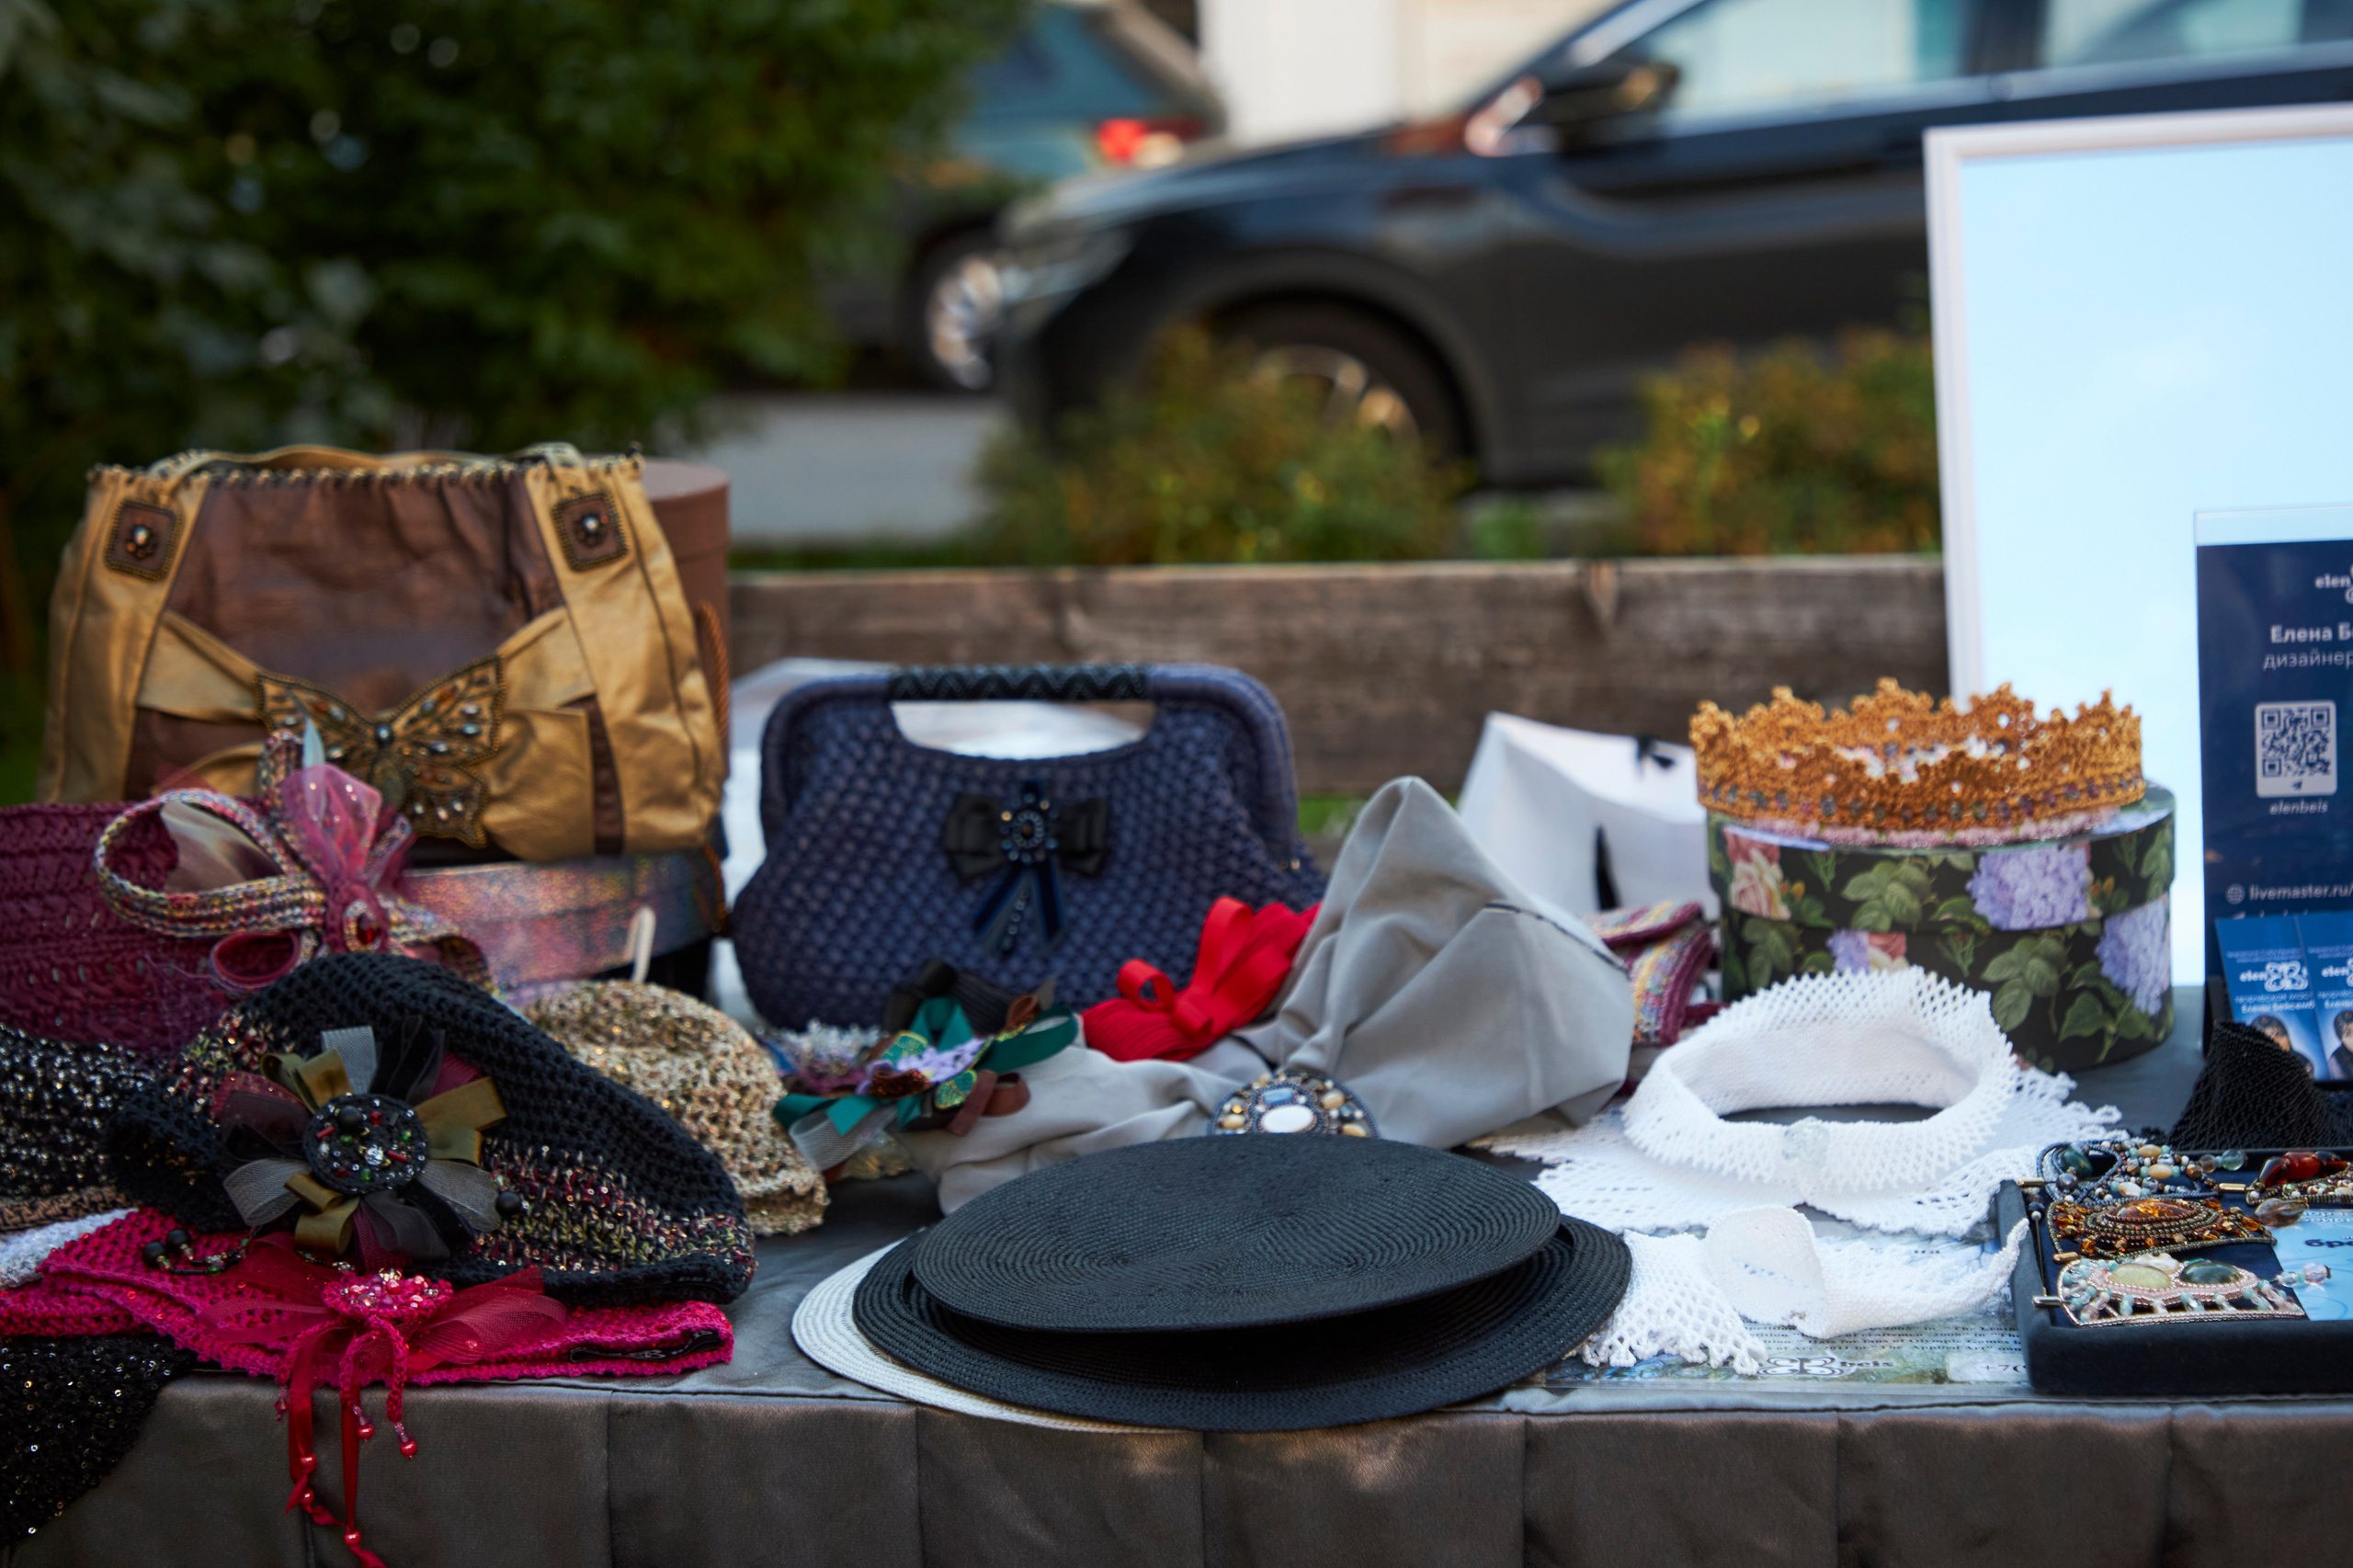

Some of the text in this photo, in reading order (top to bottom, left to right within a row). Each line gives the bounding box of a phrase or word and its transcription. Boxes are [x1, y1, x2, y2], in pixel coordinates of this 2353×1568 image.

[2270, 624, 2333, 644] Елена
[2263, 647, 2353, 671] дизайнер
[2269, 799, 2329, 815] elenbeis
[1839, 1360, 1894, 1369] beis
